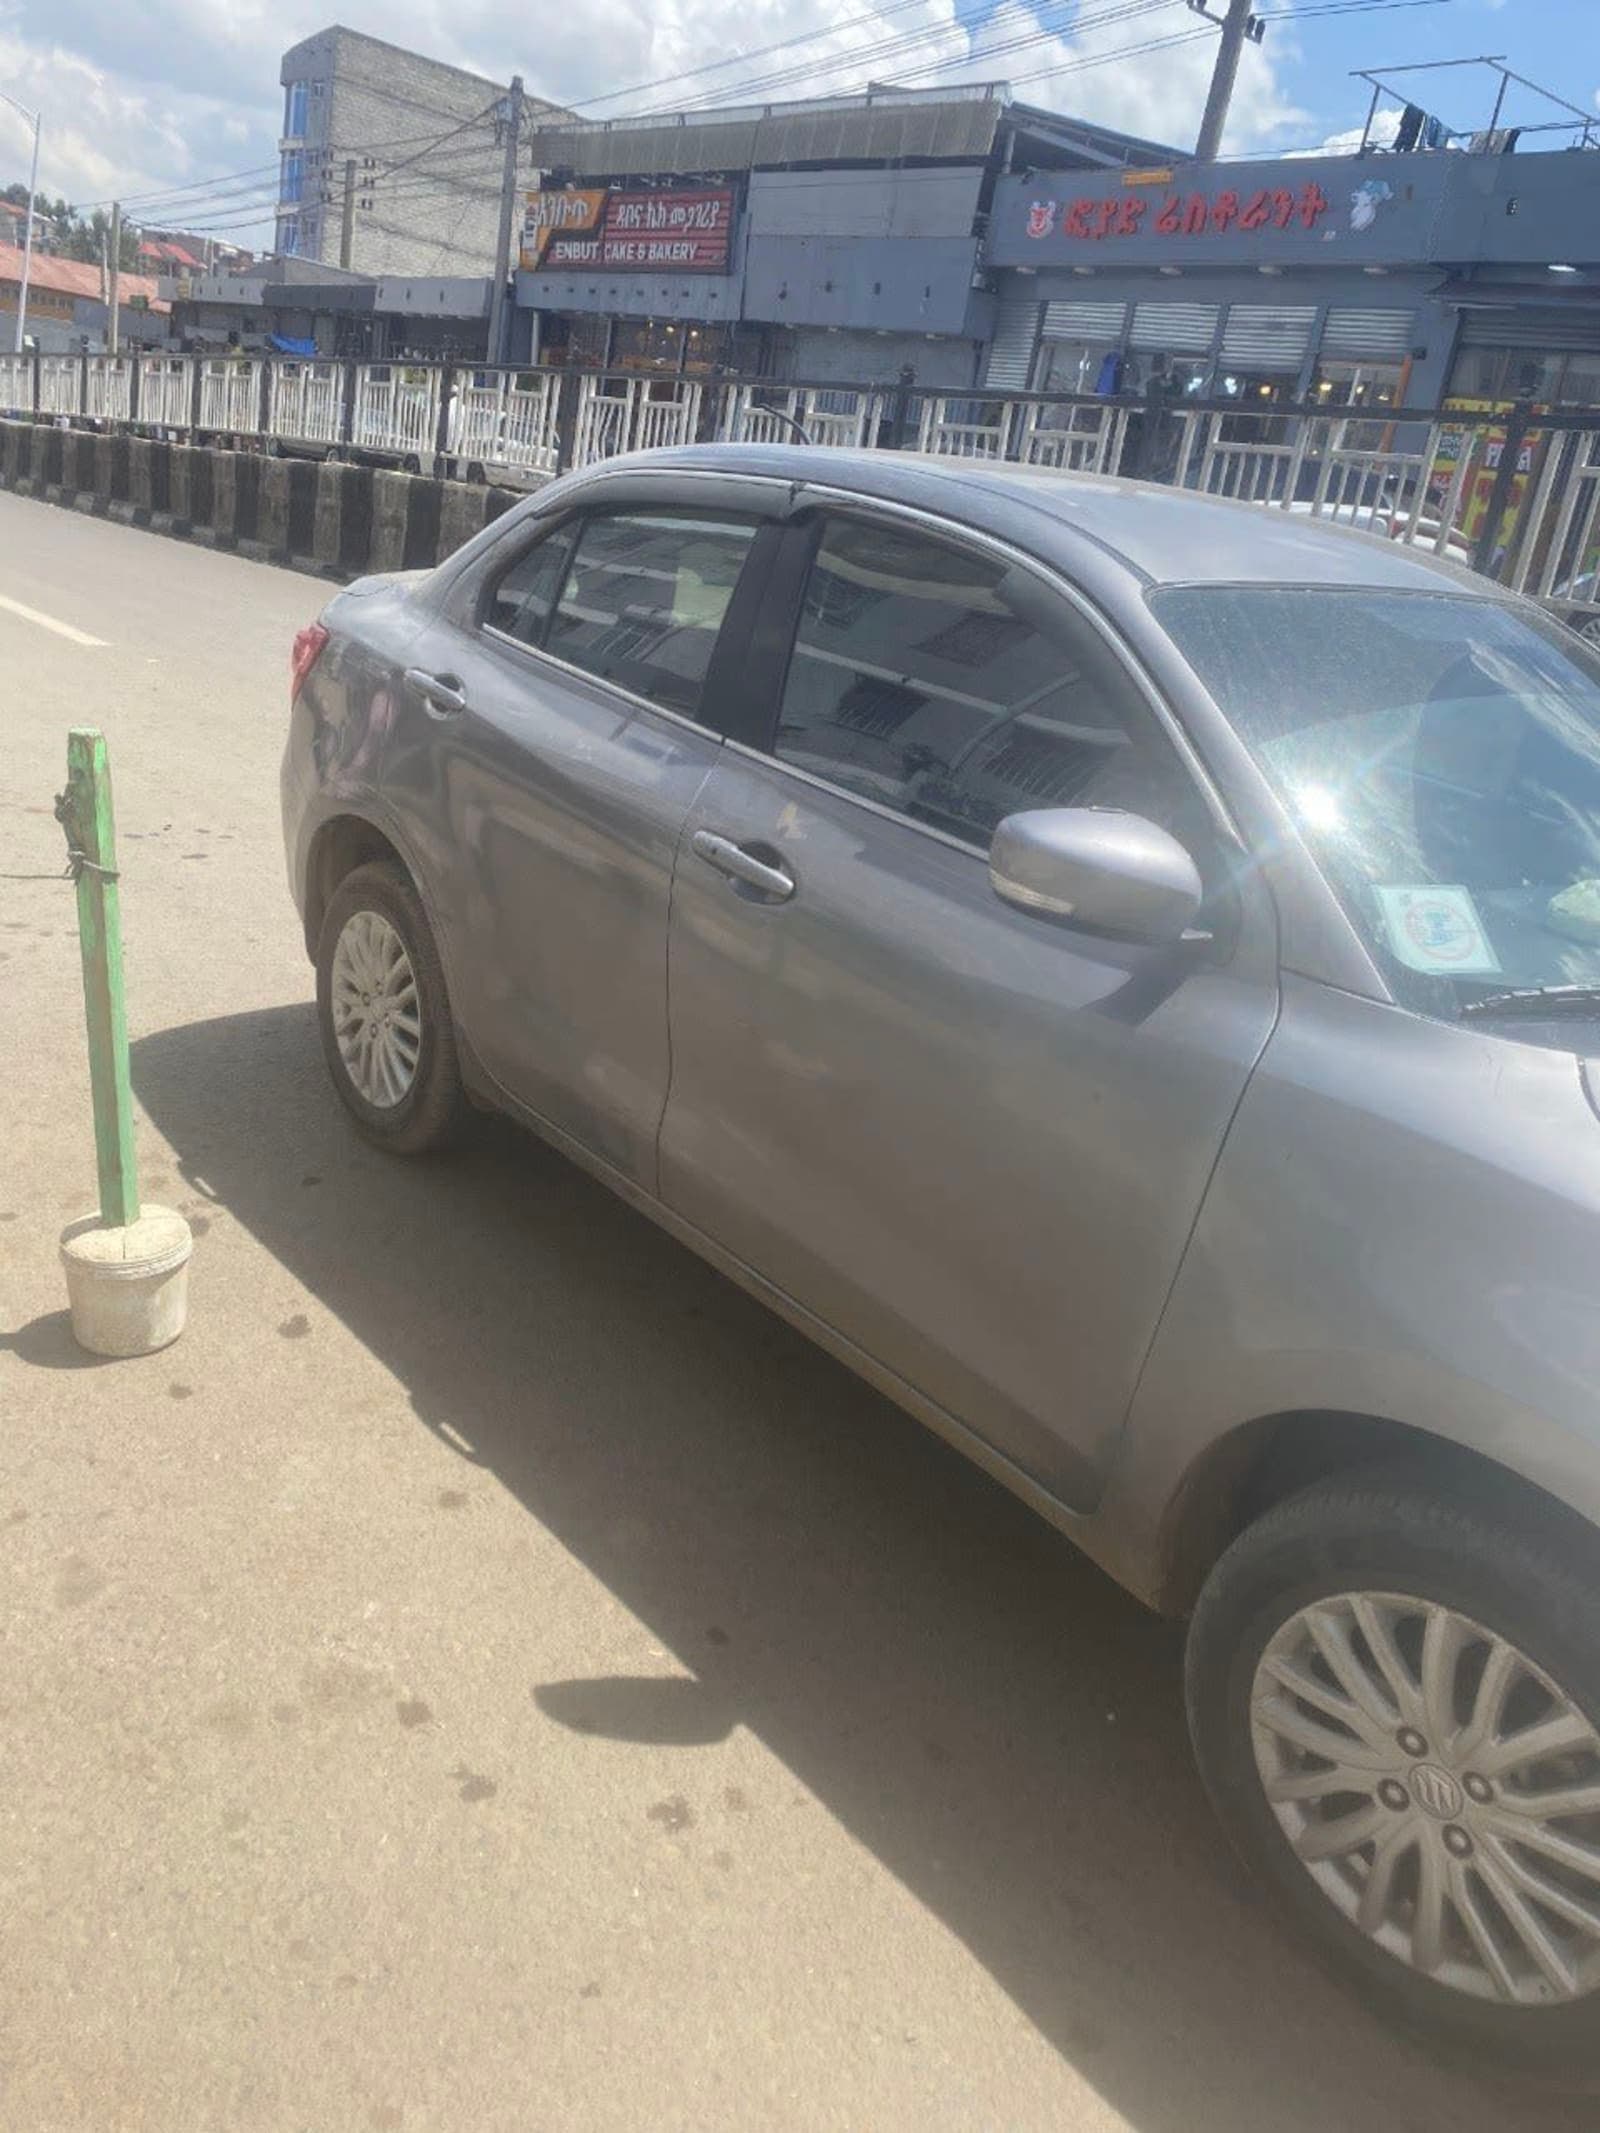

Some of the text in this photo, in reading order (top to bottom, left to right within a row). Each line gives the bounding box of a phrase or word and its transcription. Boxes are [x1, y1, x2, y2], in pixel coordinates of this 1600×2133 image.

[555, 241, 599, 261] ENBUT
[604, 241, 636, 261] CAKE
[649, 241, 698, 261] BAKERY
